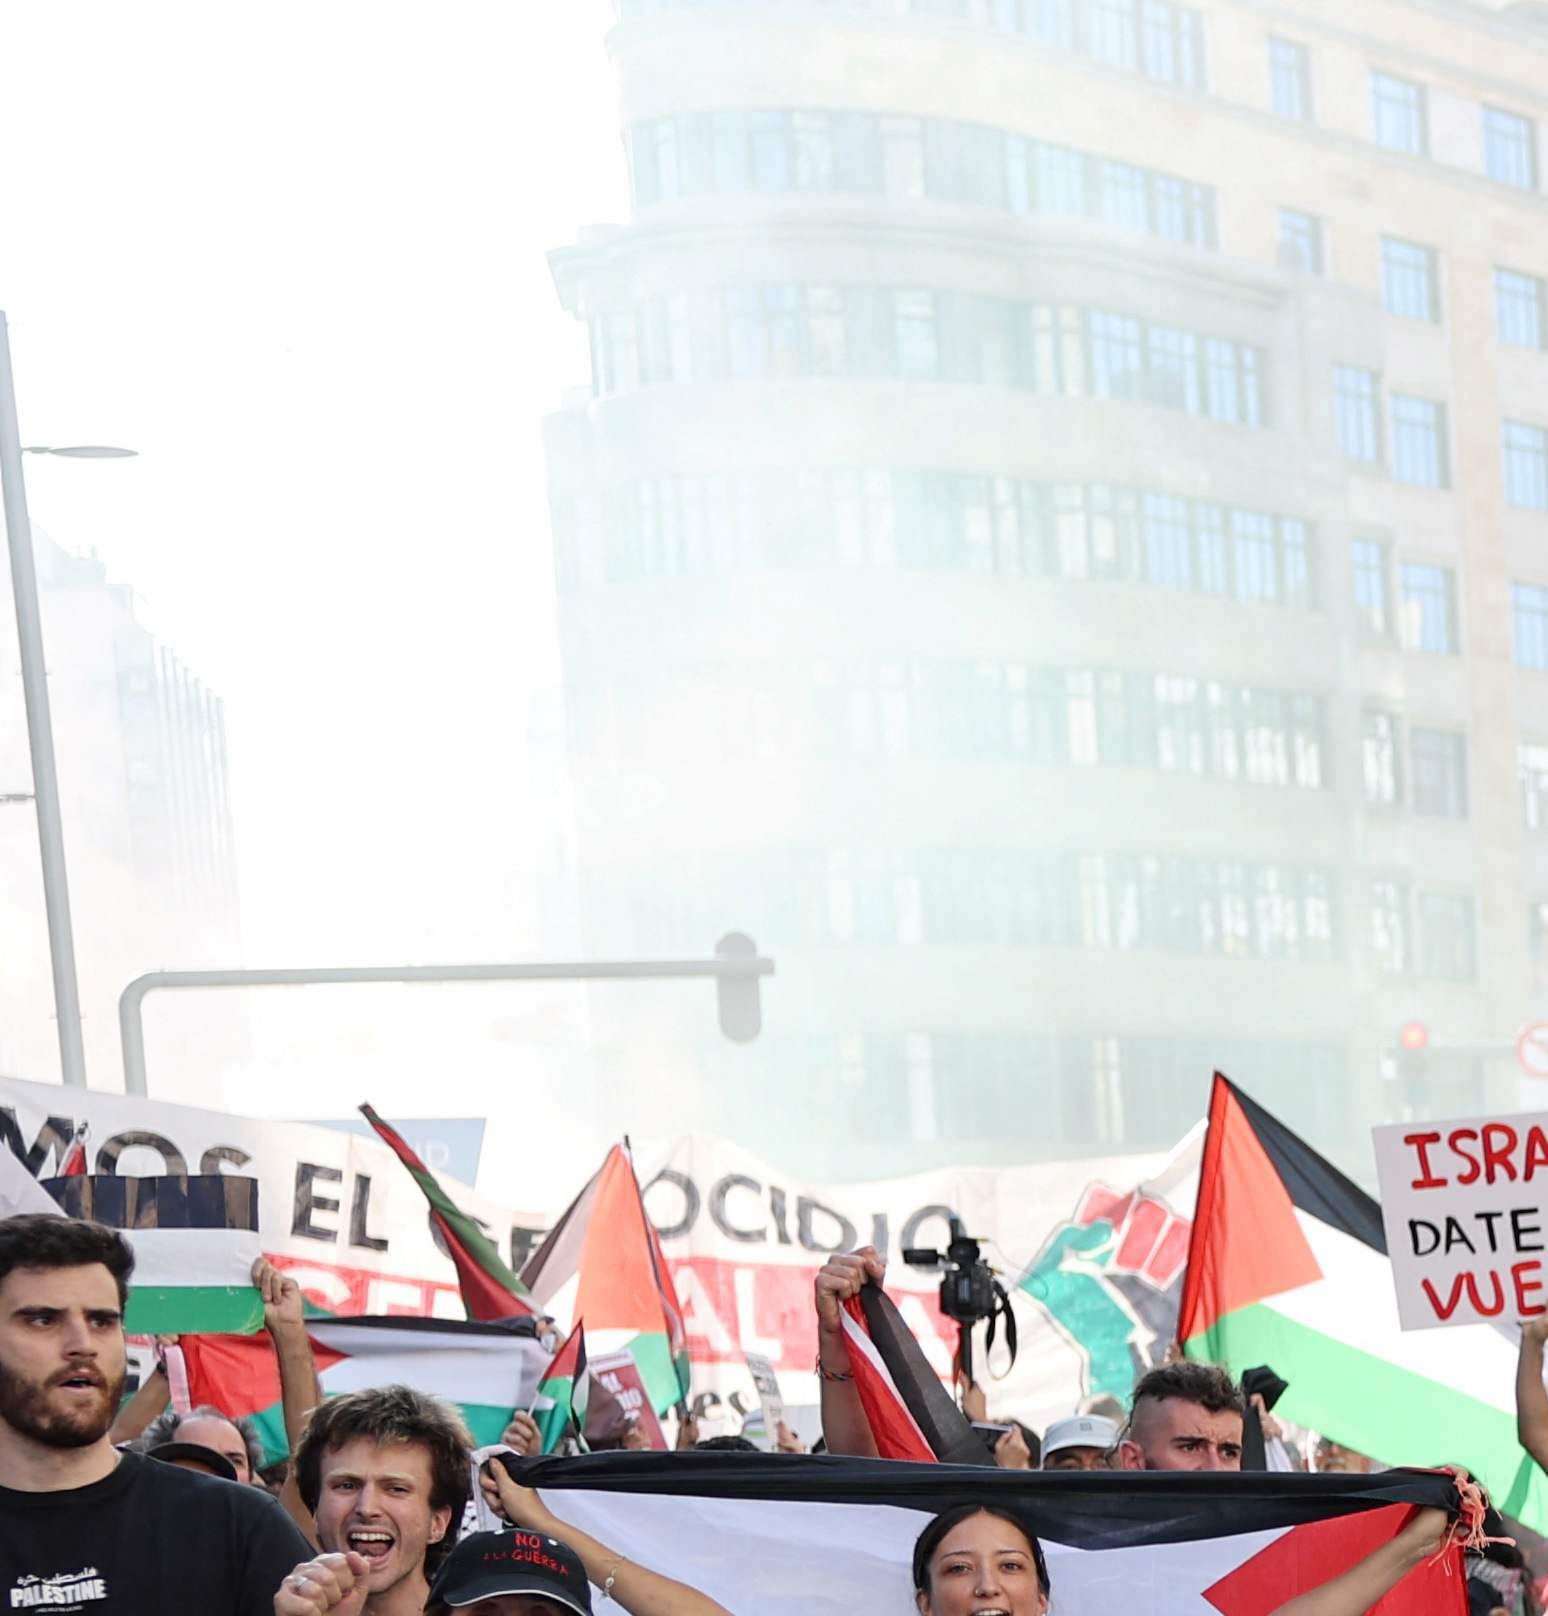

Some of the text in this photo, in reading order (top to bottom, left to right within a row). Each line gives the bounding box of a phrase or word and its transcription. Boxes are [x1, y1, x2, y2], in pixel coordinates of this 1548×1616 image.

[290, 1161, 390, 1252] EL
[1408, 1207, 1545, 1256] DATE
[514, 1532, 541, 1549] NO
[511, 1548, 569, 1576] GUERRA
[10, 1578, 107, 1608] PALESTINE
